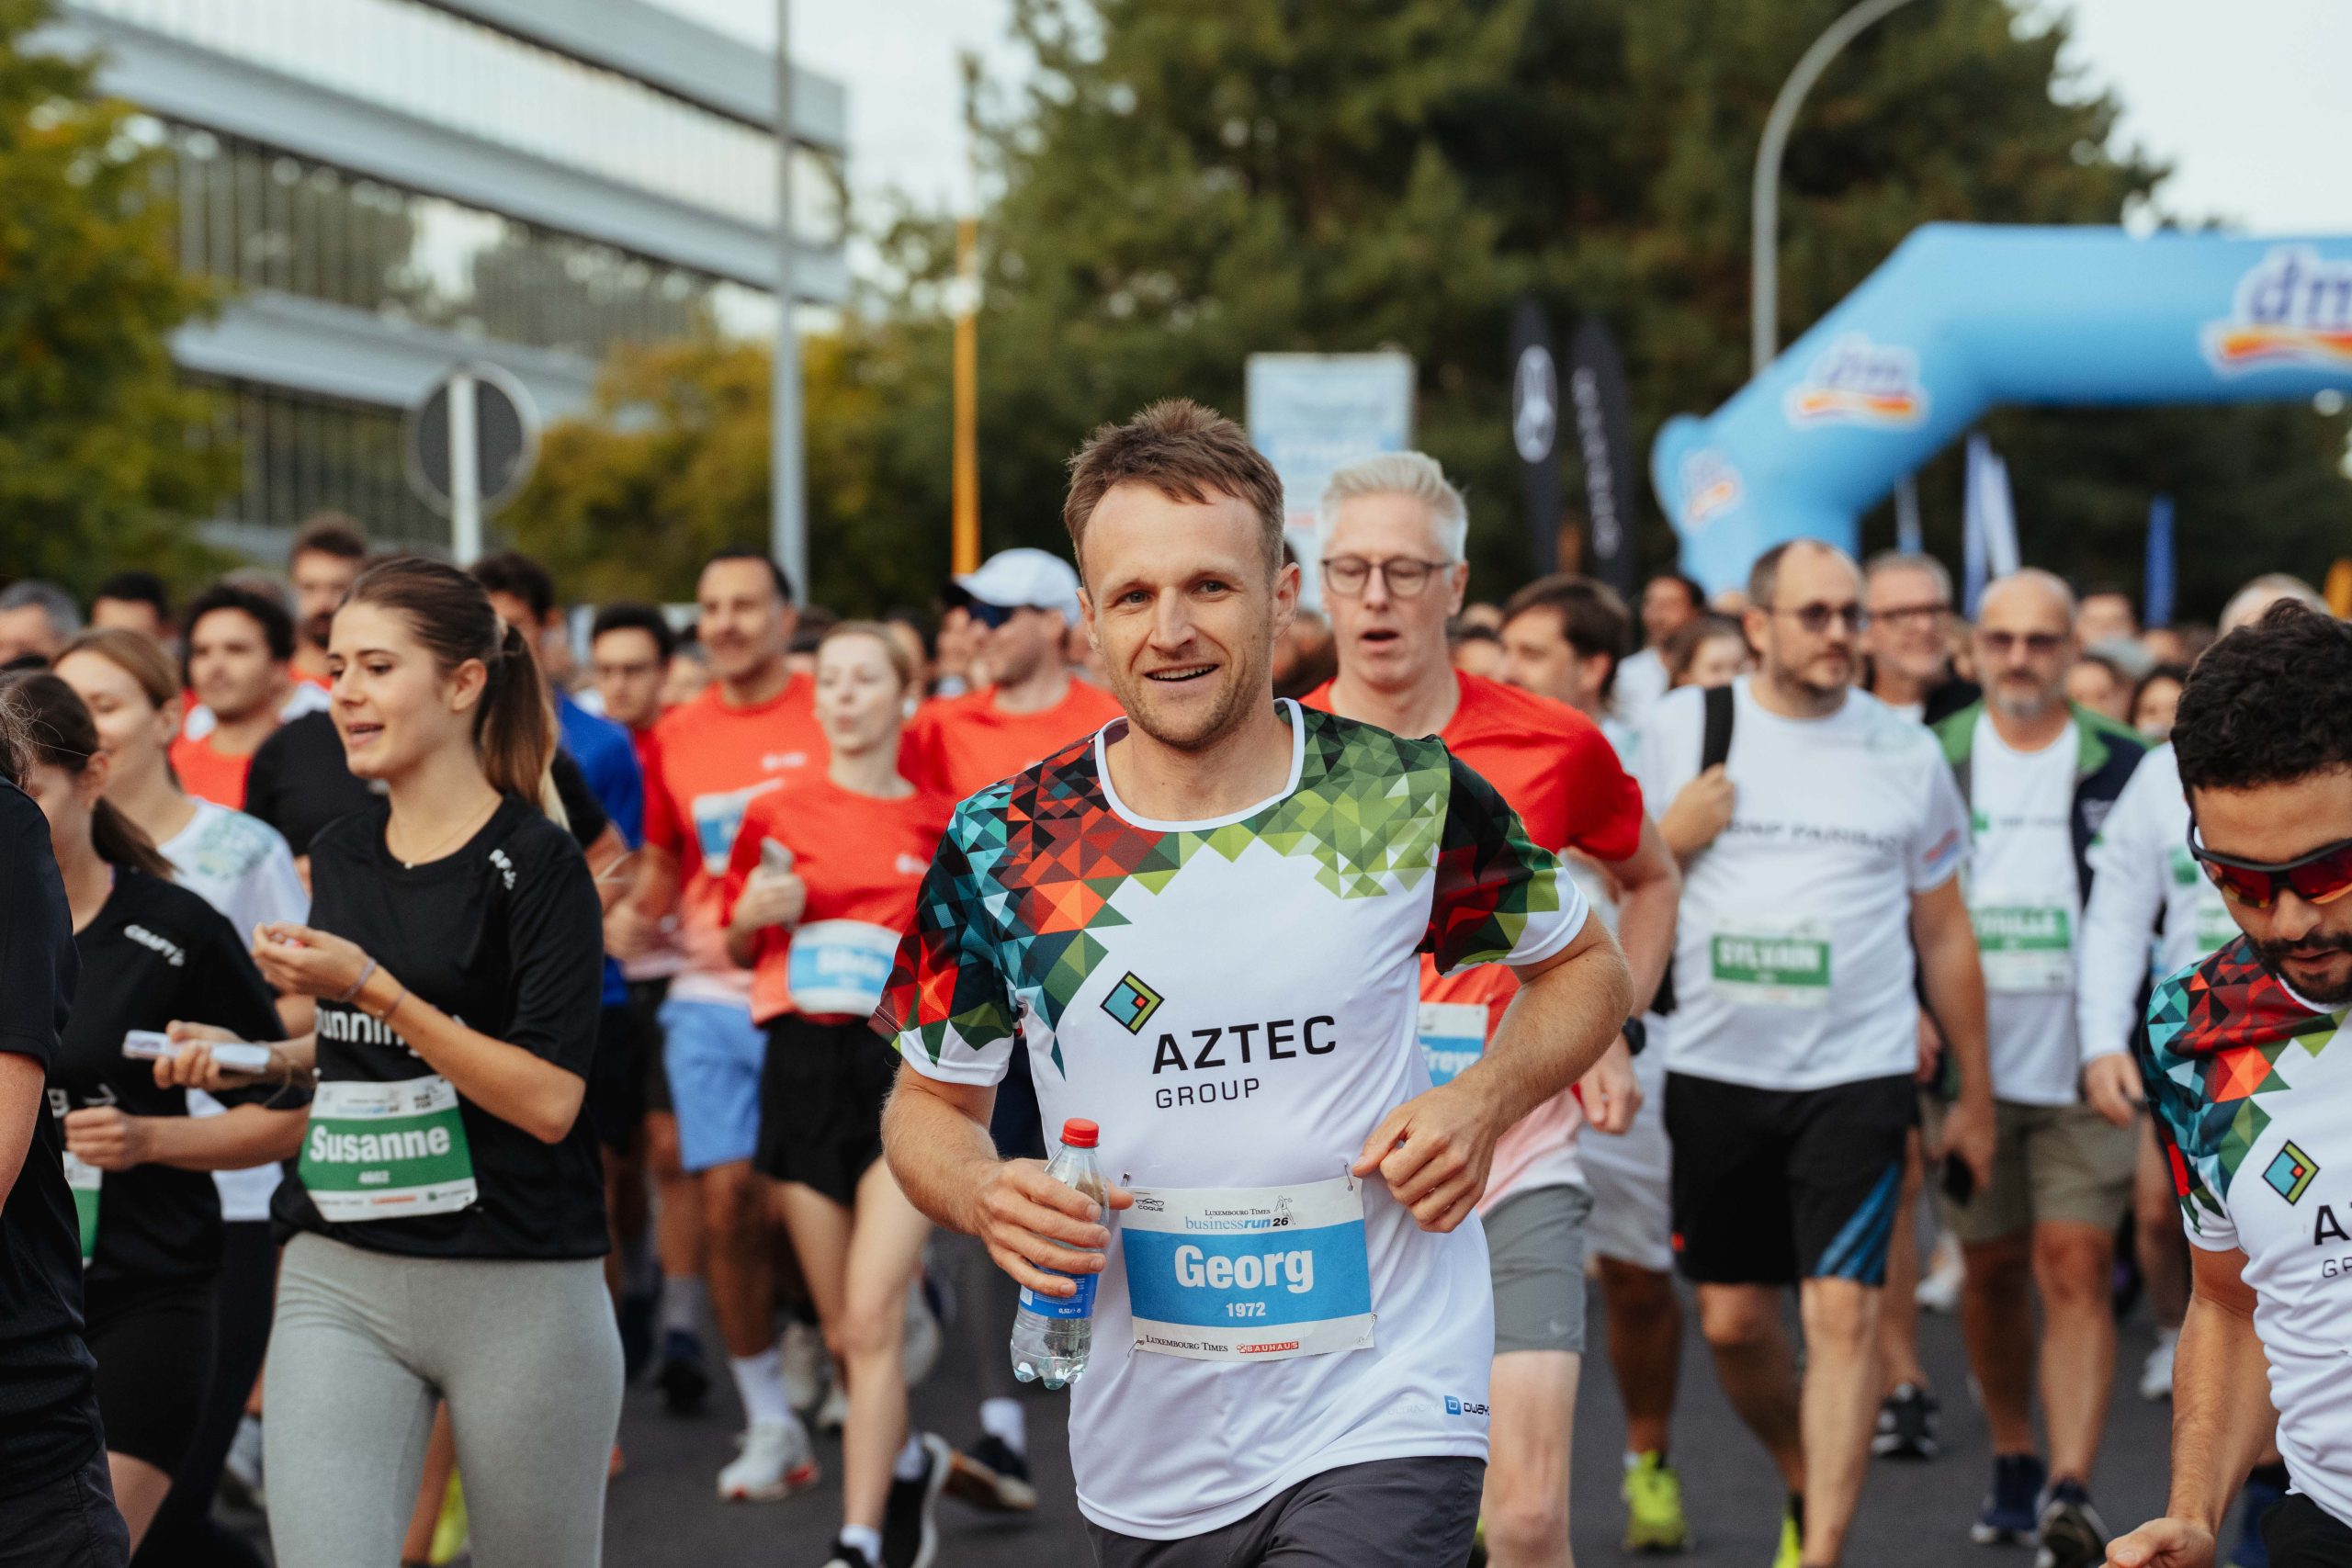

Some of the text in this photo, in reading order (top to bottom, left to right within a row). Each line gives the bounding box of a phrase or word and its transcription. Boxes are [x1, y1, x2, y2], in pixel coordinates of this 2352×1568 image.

[1152, 1015, 1336, 1075] AZTEC
[1156, 1077, 1260, 1109] GROUP
[310, 1125, 450, 1163] Susanne
[1272, 1217, 1289, 1227] 26
[2314, 1201, 2352, 1246] A
[1174, 1245, 1314, 1294] Georg
[1226, 1302, 1266, 1317] 1972
[1247, 1341, 1299, 1353] BAUHAUS
